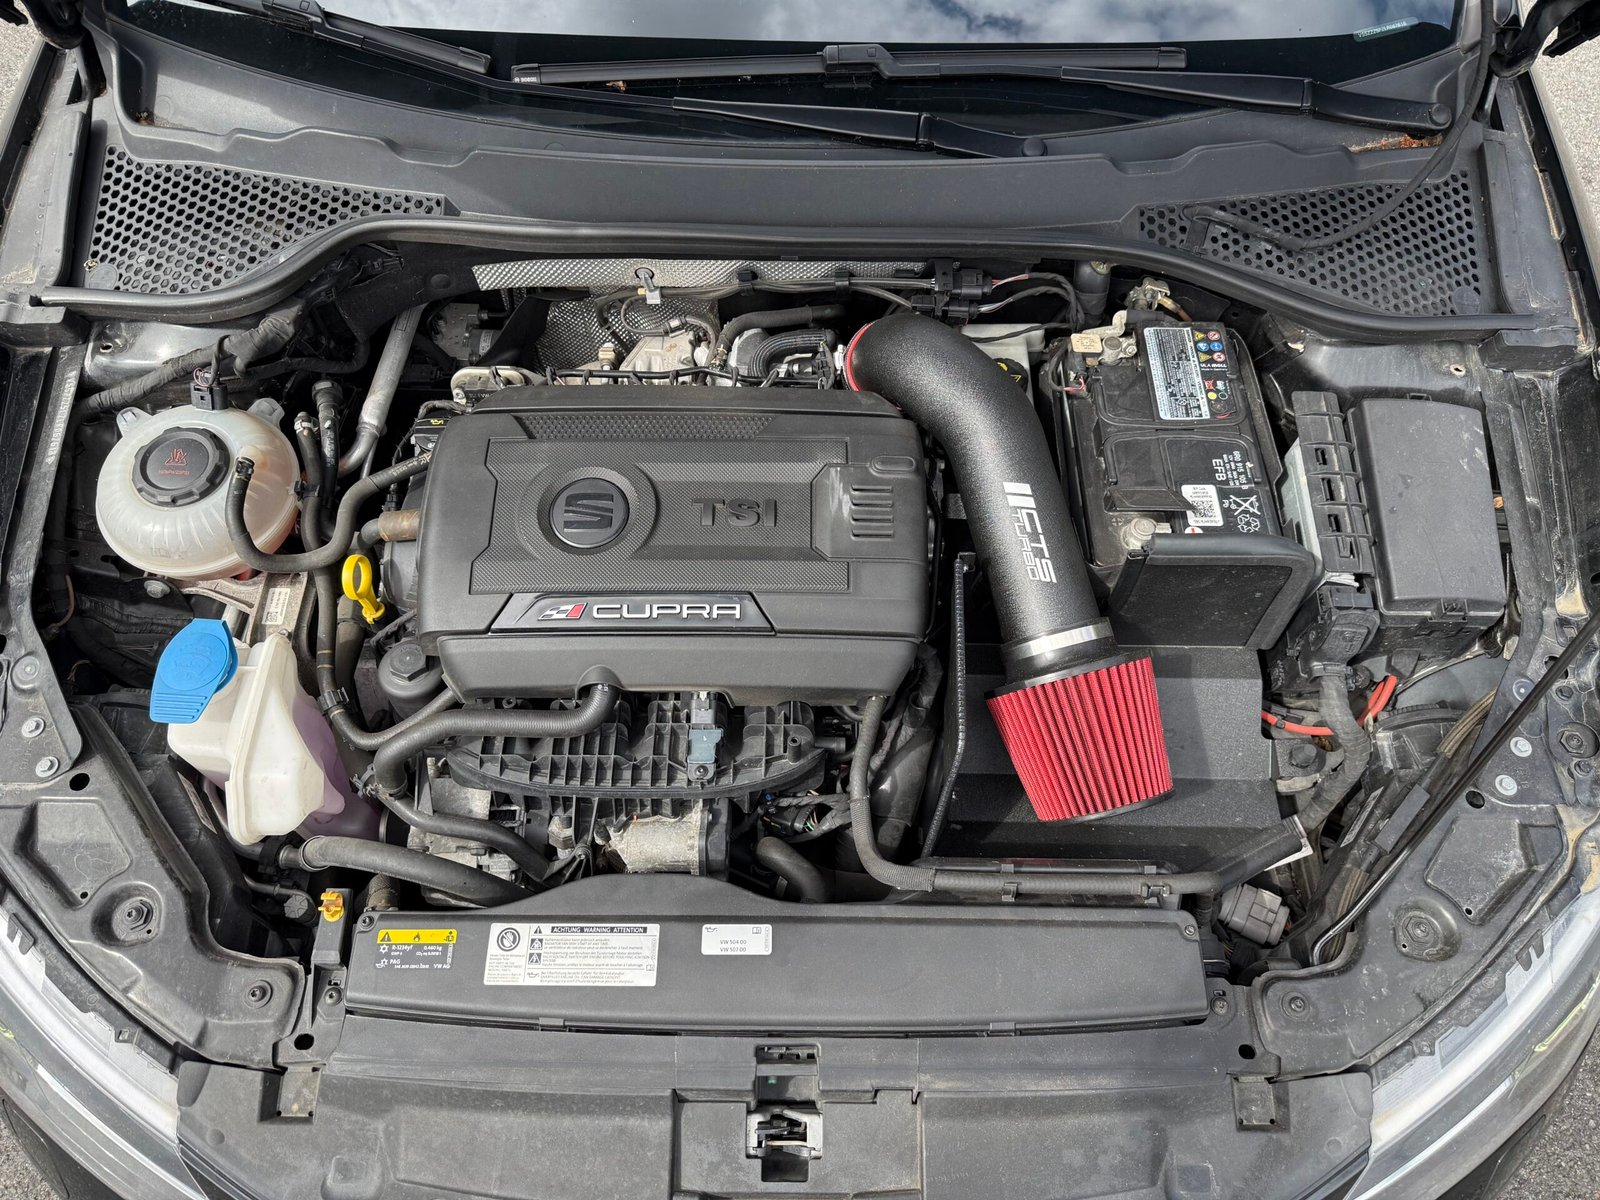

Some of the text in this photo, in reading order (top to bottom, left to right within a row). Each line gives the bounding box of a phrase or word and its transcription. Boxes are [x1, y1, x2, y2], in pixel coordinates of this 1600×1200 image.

[1212, 459, 1227, 481] EFB
[692, 498, 777, 528] TSI
[1222, 499, 1229, 508] Pb
[1012, 508, 1040, 580] TURBO
[1021, 509, 1057, 583] CTS
[592, 603, 741, 620] CUPRA
